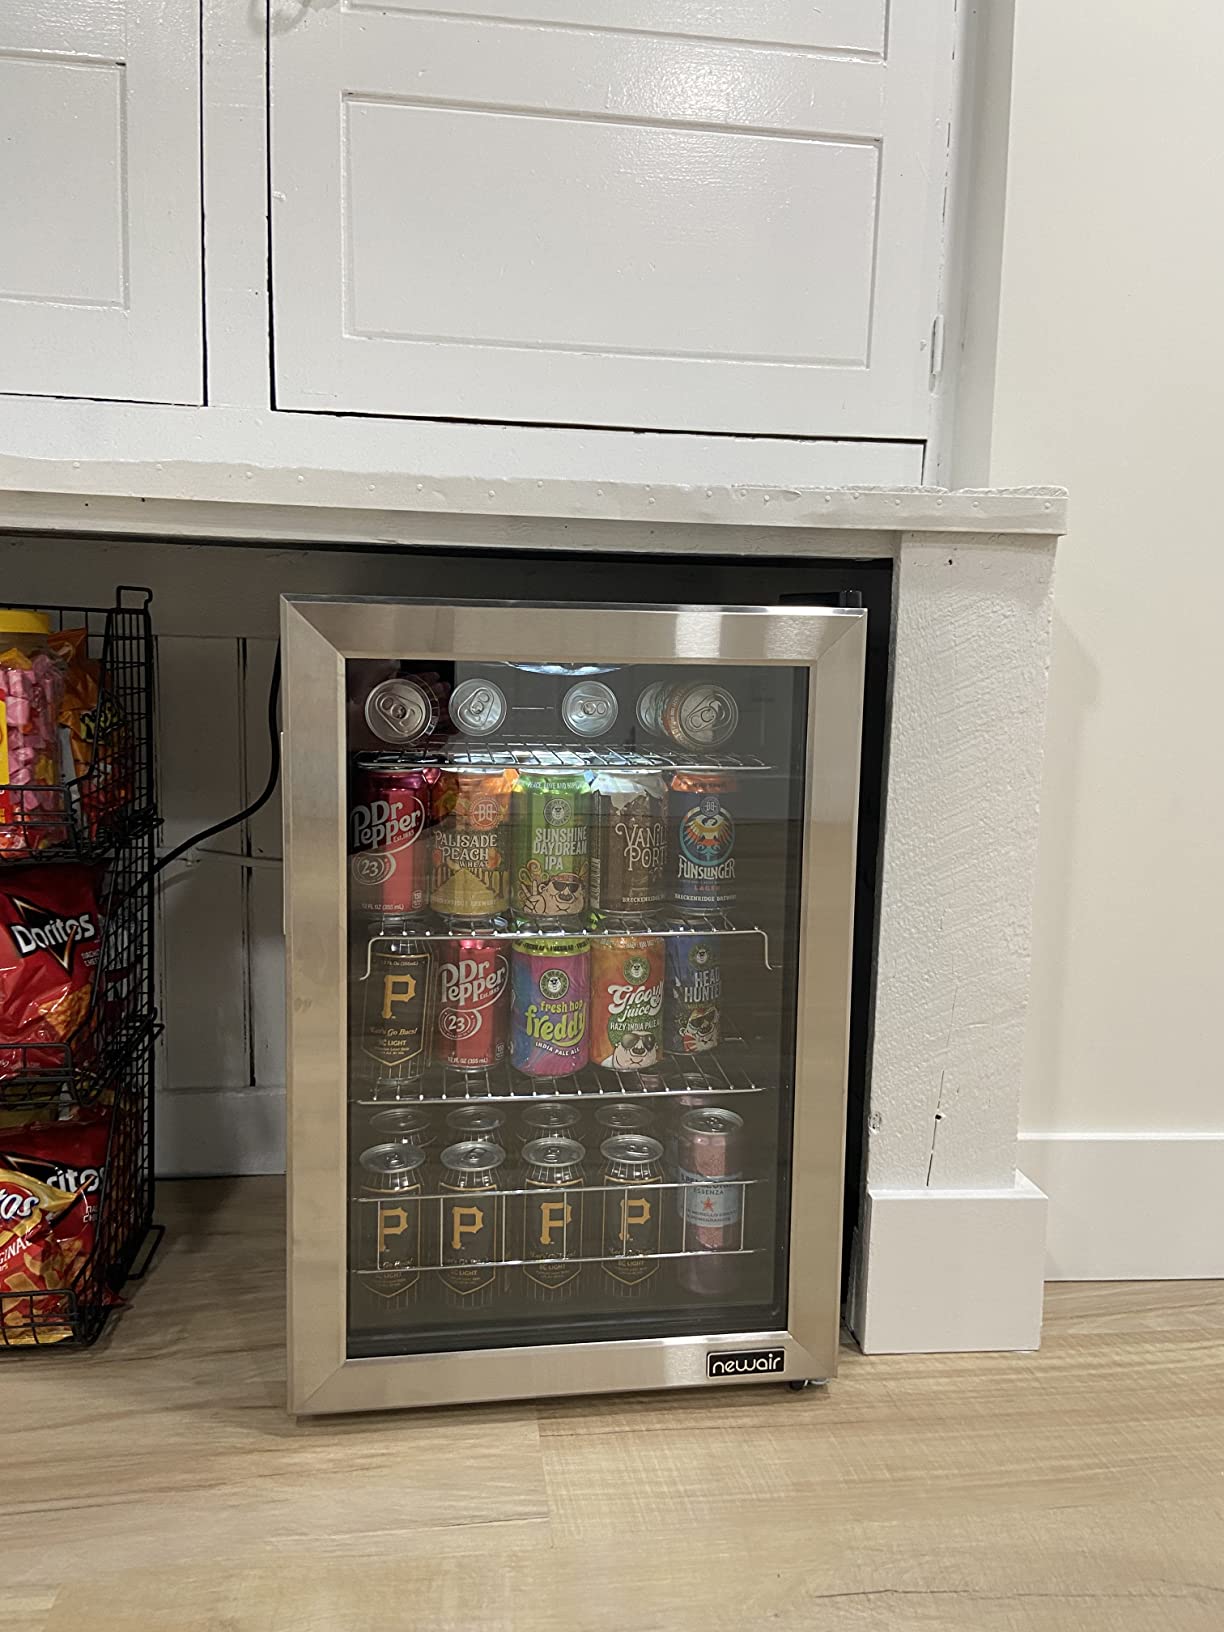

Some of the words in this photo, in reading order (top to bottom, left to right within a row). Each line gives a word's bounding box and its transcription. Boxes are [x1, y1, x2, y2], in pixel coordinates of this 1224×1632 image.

[370, 800, 403, 826] Dr
[351, 804, 421, 849] Pepper
[535, 826, 587, 843] SUNSHINE
[433, 830, 498, 850] PALISADE
[440, 846, 489, 864] PEACH
[545, 856, 564, 870] IPA
[360, 859, 380, 877] 23
[677, 854, 736, 880] FUNSLINGER
[10, 914, 95, 954] Doritos
[458, 959, 490, 985] Dr
[439, 963, 506, 1006] Pepper
[382, 974, 417, 1019] P
[607, 978, 665, 1016] Groovy
[540, 1001, 567, 1013] fresh
[617, 1004, 650, 1022] juice
[448, 1015, 466, 1032] 23
[524, 1002, 587, 1047] freddy
[610, 1022, 627, 1031] HAZY
[627, 1023, 644, 1032] INDIA
[535, 1041, 553, 1052] INDIA
[554, 1048, 569, 1056] PALE
[693, 1187, 724, 1196] ESSENZA
[451, 1206, 484, 1250] P
[712, 1353, 781, 1374] newair
